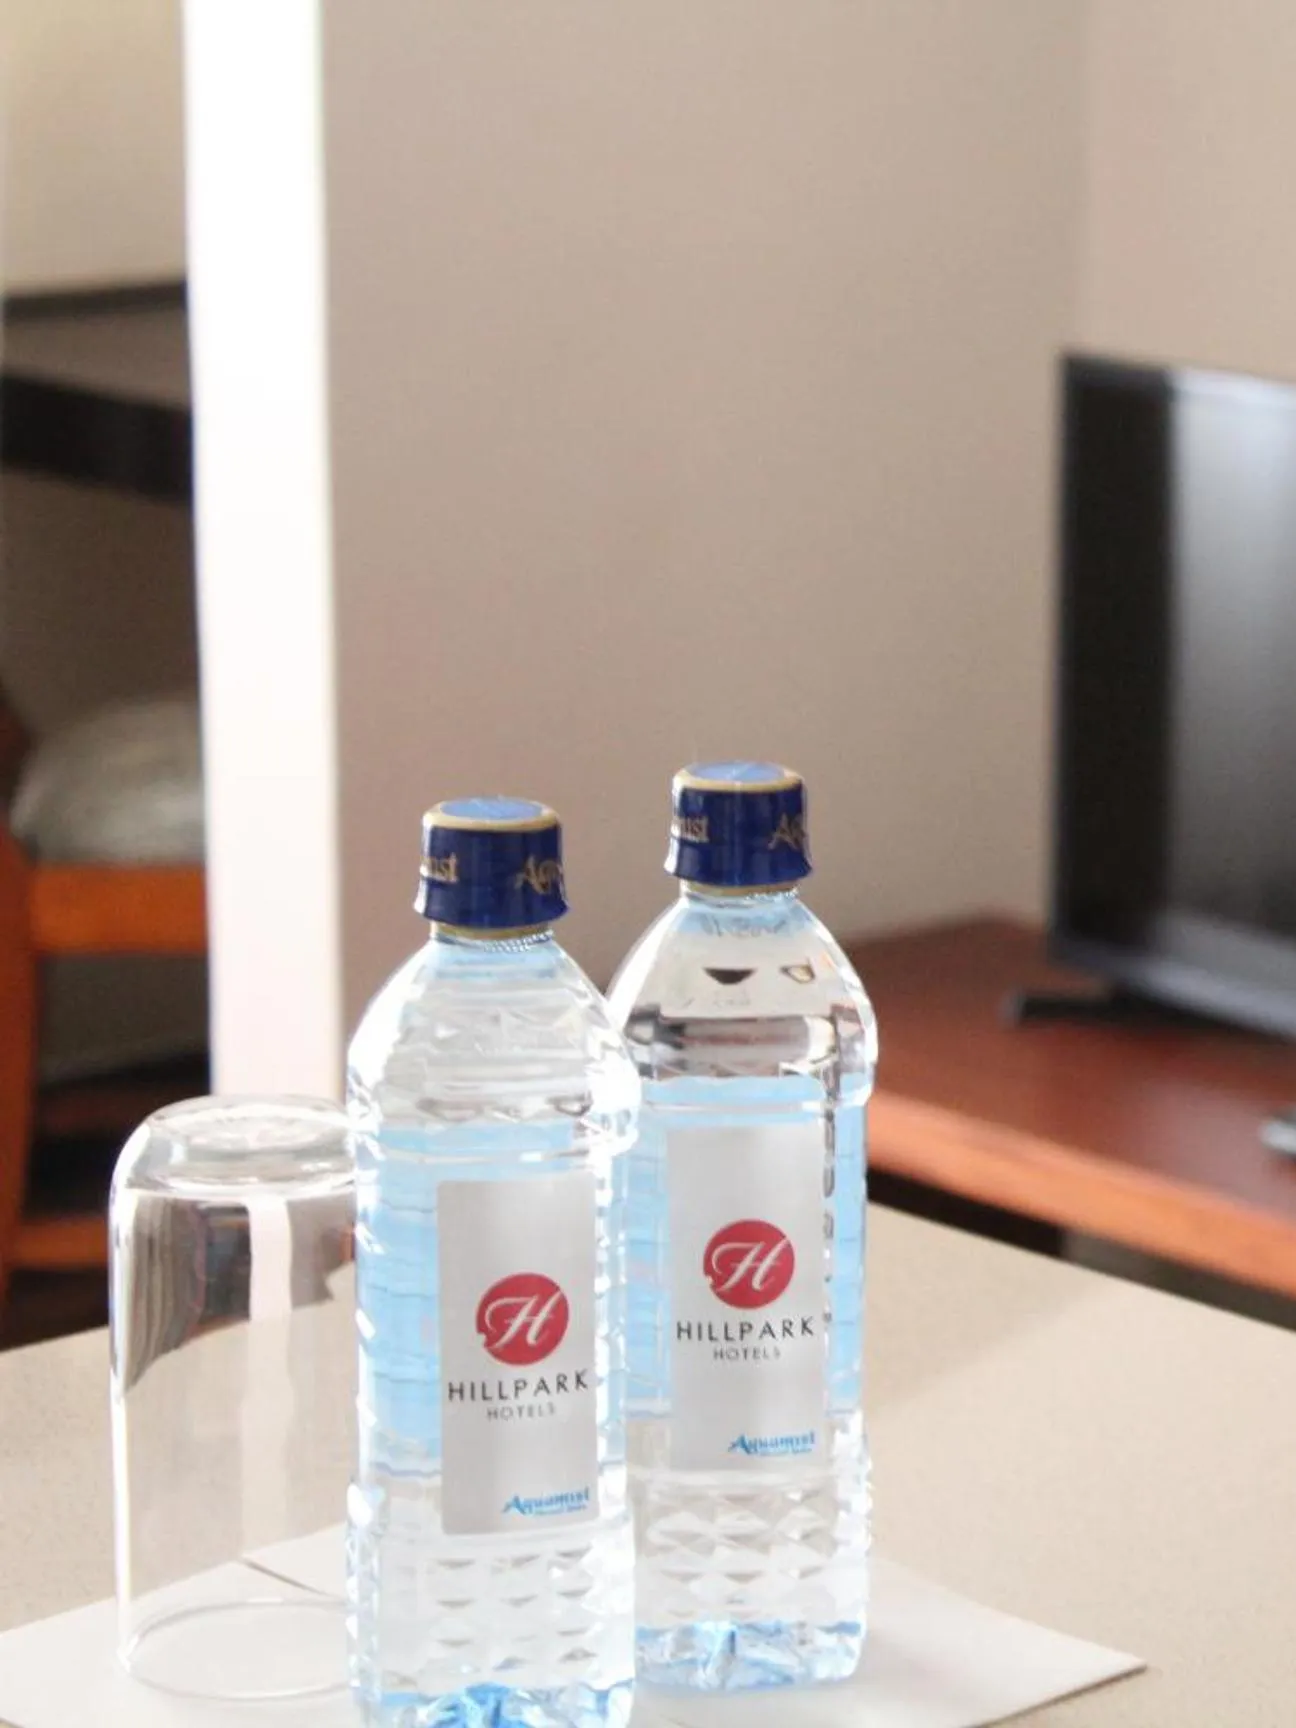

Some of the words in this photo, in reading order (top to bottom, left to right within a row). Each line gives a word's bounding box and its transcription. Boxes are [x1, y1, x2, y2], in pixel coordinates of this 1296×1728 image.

[676, 1315, 815, 1342] HILLPARK
[712, 1346, 781, 1361] HOTELS
[447, 1368, 588, 1403] HILLPARK
[486, 1402, 556, 1421] HOTELS
